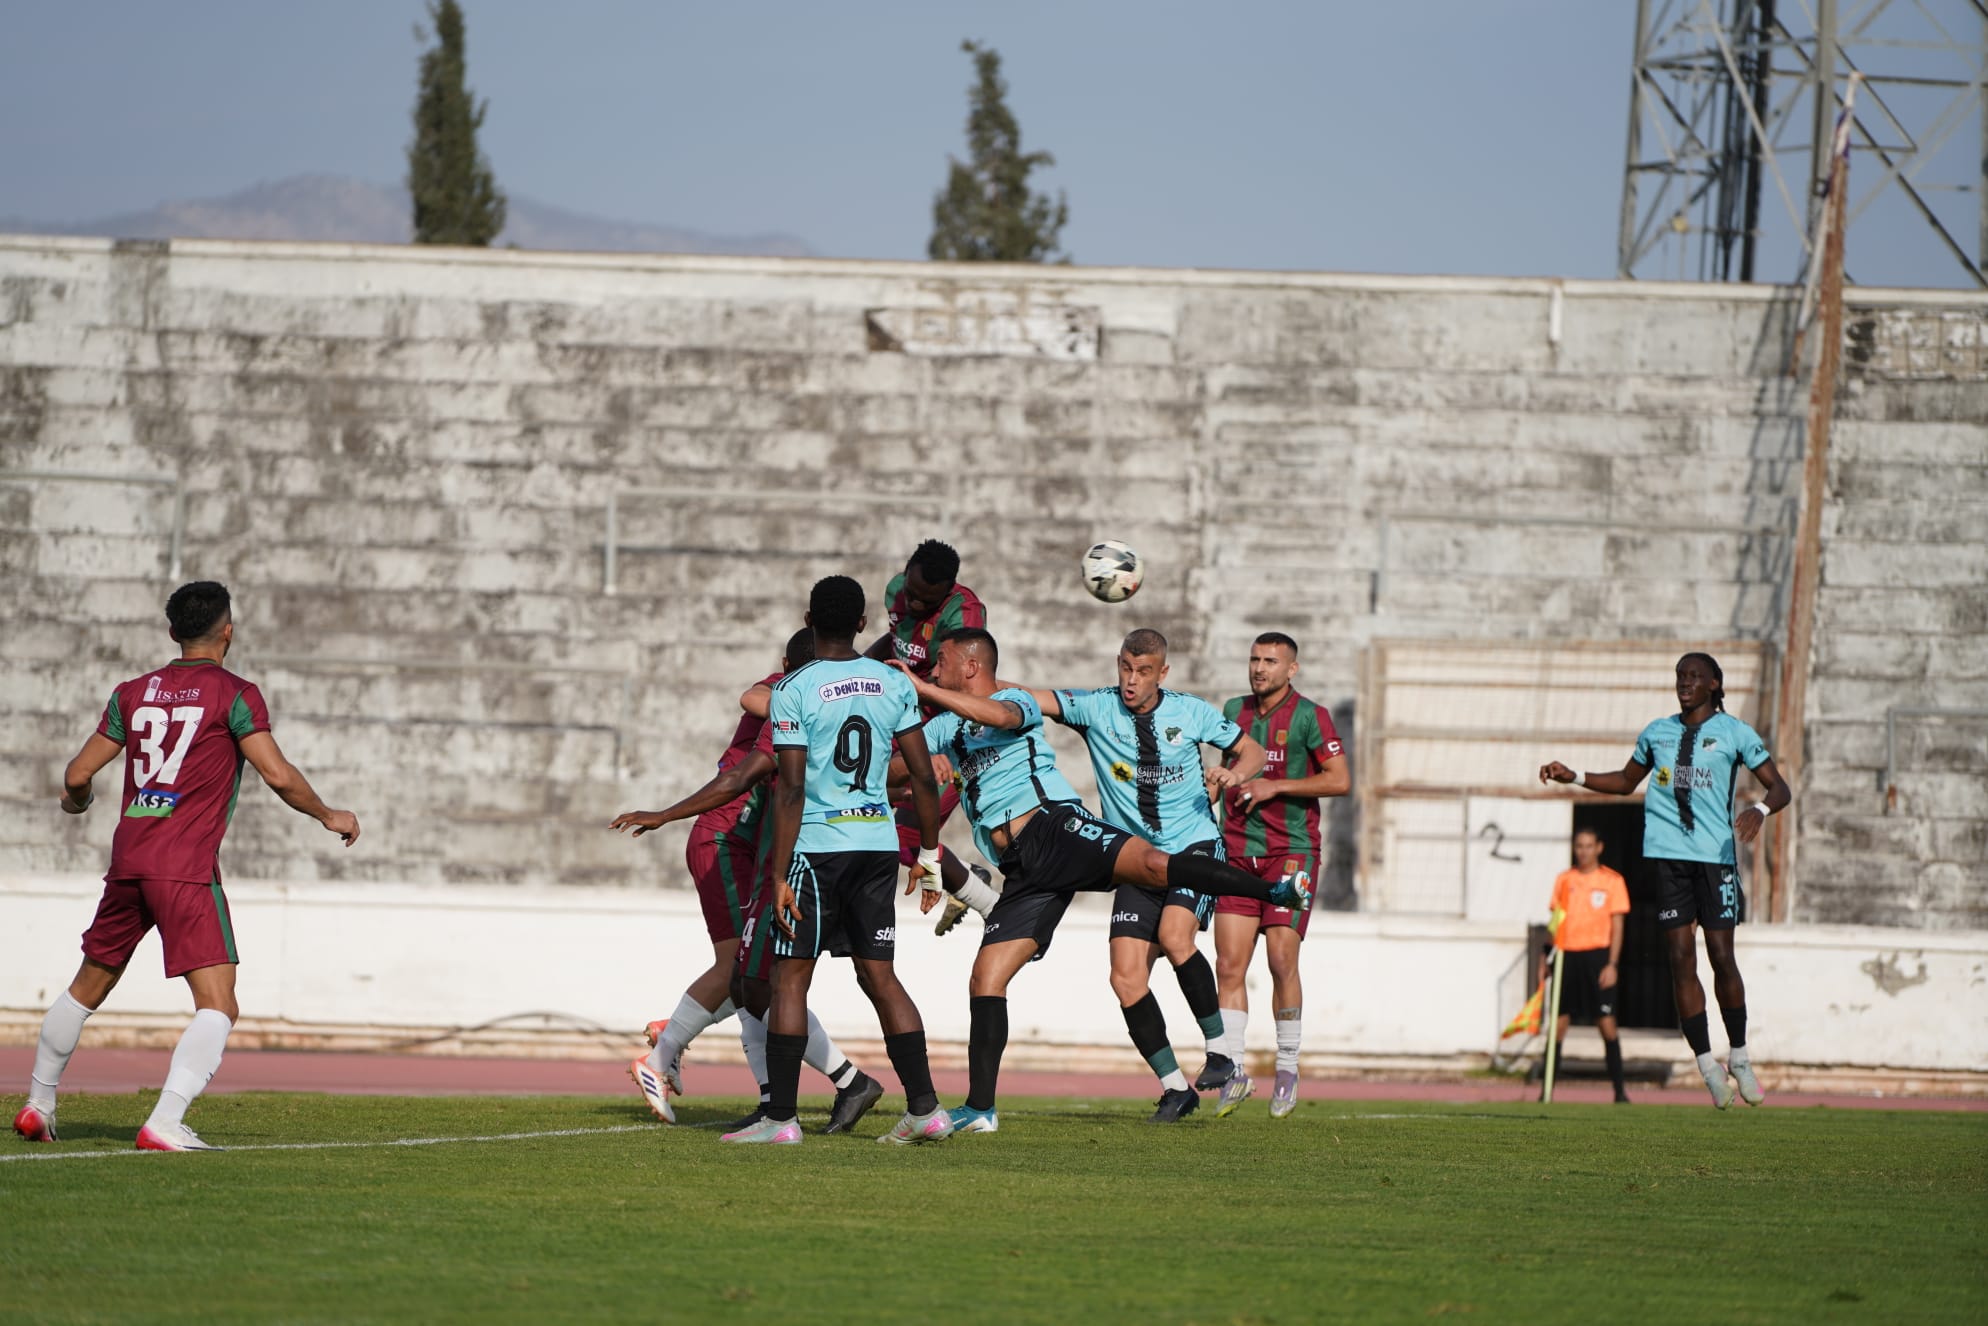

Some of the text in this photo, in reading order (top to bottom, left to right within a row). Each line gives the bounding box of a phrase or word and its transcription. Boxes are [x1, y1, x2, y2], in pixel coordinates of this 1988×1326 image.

[772, 720, 799, 731] MEN
[131, 706, 205, 789] 37
[833, 714, 872, 793] 9
[1327, 741, 1340, 752] C
[1079, 823, 1103, 841] 8
[1480, 821, 1524, 863] 2
[1719, 884, 1735, 906] 15
[742, 917, 756, 948] 4
